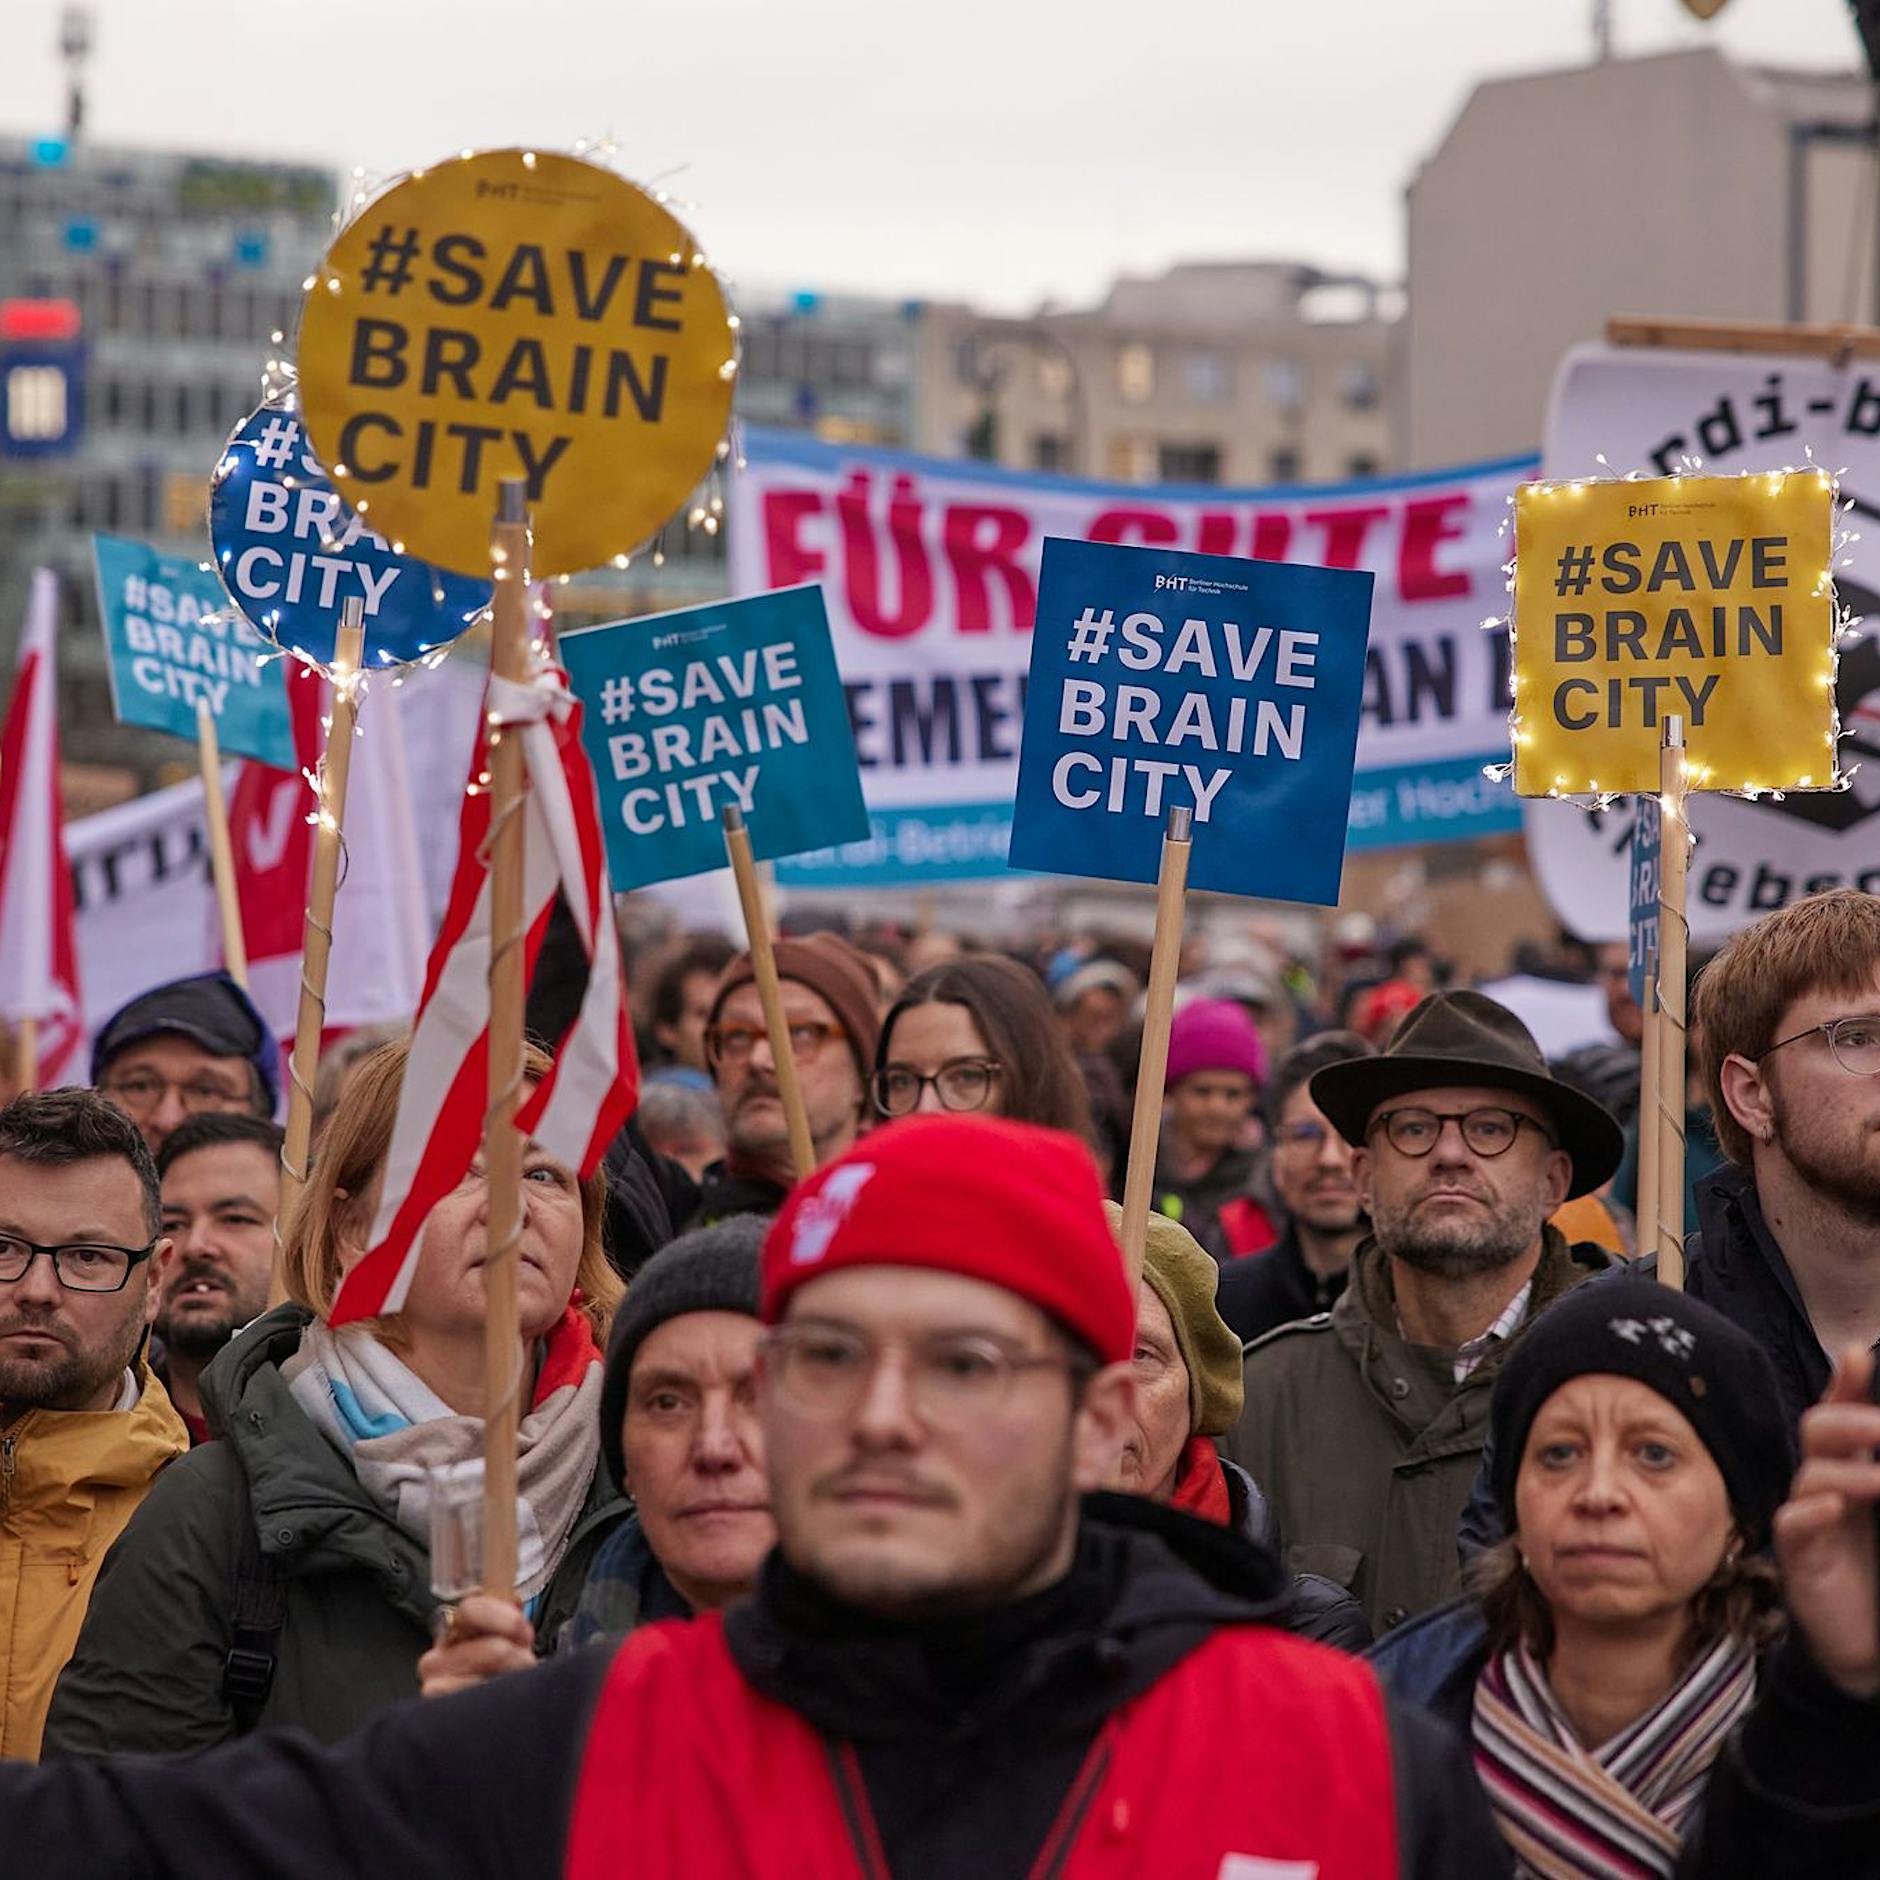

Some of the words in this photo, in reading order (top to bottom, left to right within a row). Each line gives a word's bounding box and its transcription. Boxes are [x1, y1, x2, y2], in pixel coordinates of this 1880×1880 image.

[361, 224, 687, 333] #SAVE
[349, 317, 669, 424] BRAIN
[337, 413, 572, 503] CITY
[1629, 504, 1658, 517] BHT
[236, 546, 401, 616] CITY
[1153, 574, 1188, 593] BHT
[1554, 536, 1789, 597] #SAVE
[124, 573, 264, 648] #SAVE
[1553, 605, 1783, 663] BRAIN
[124, 613, 263, 689] BRAIN
[599, 641, 802, 726] #SAVE
[1067, 607, 1320, 689] #SAVE
[132, 655, 230, 716] CITY
[1058, 678, 1306, 760] BRAIN
[1552, 674, 1720, 730] CITY
[608, 699, 809, 781] BRAIN
[621, 766, 761, 835] CITY
[1051, 751, 1232, 824] CITY
